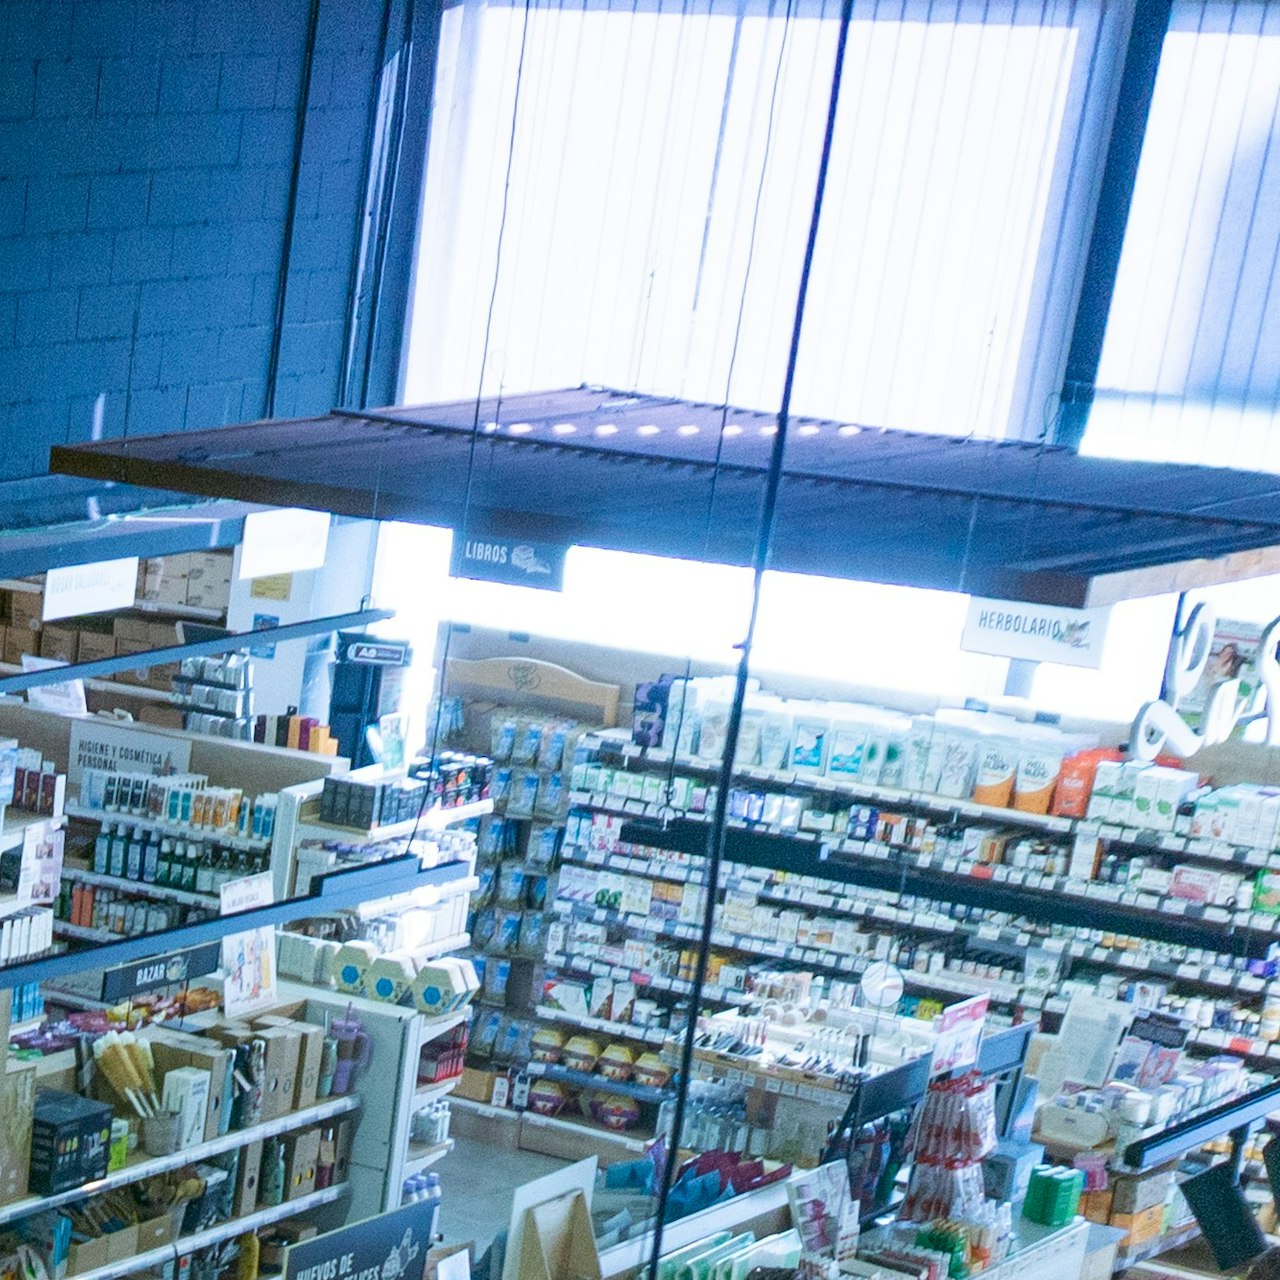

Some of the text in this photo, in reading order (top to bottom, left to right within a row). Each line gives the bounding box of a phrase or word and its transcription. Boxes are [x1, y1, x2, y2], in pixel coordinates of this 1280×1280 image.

[465, 541, 508, 564] LIBROS
[978, 611, 1061, 639] HERBOLARIO
[77, 753, 117, 772] PERSONAL
[79, 739, 109, 757] HIGIENE
[118, 746, 162, 766] COSMÉTICA
[136, 963, 166, 986] BAZAR
[339, 1252, 354, 1276] DE
